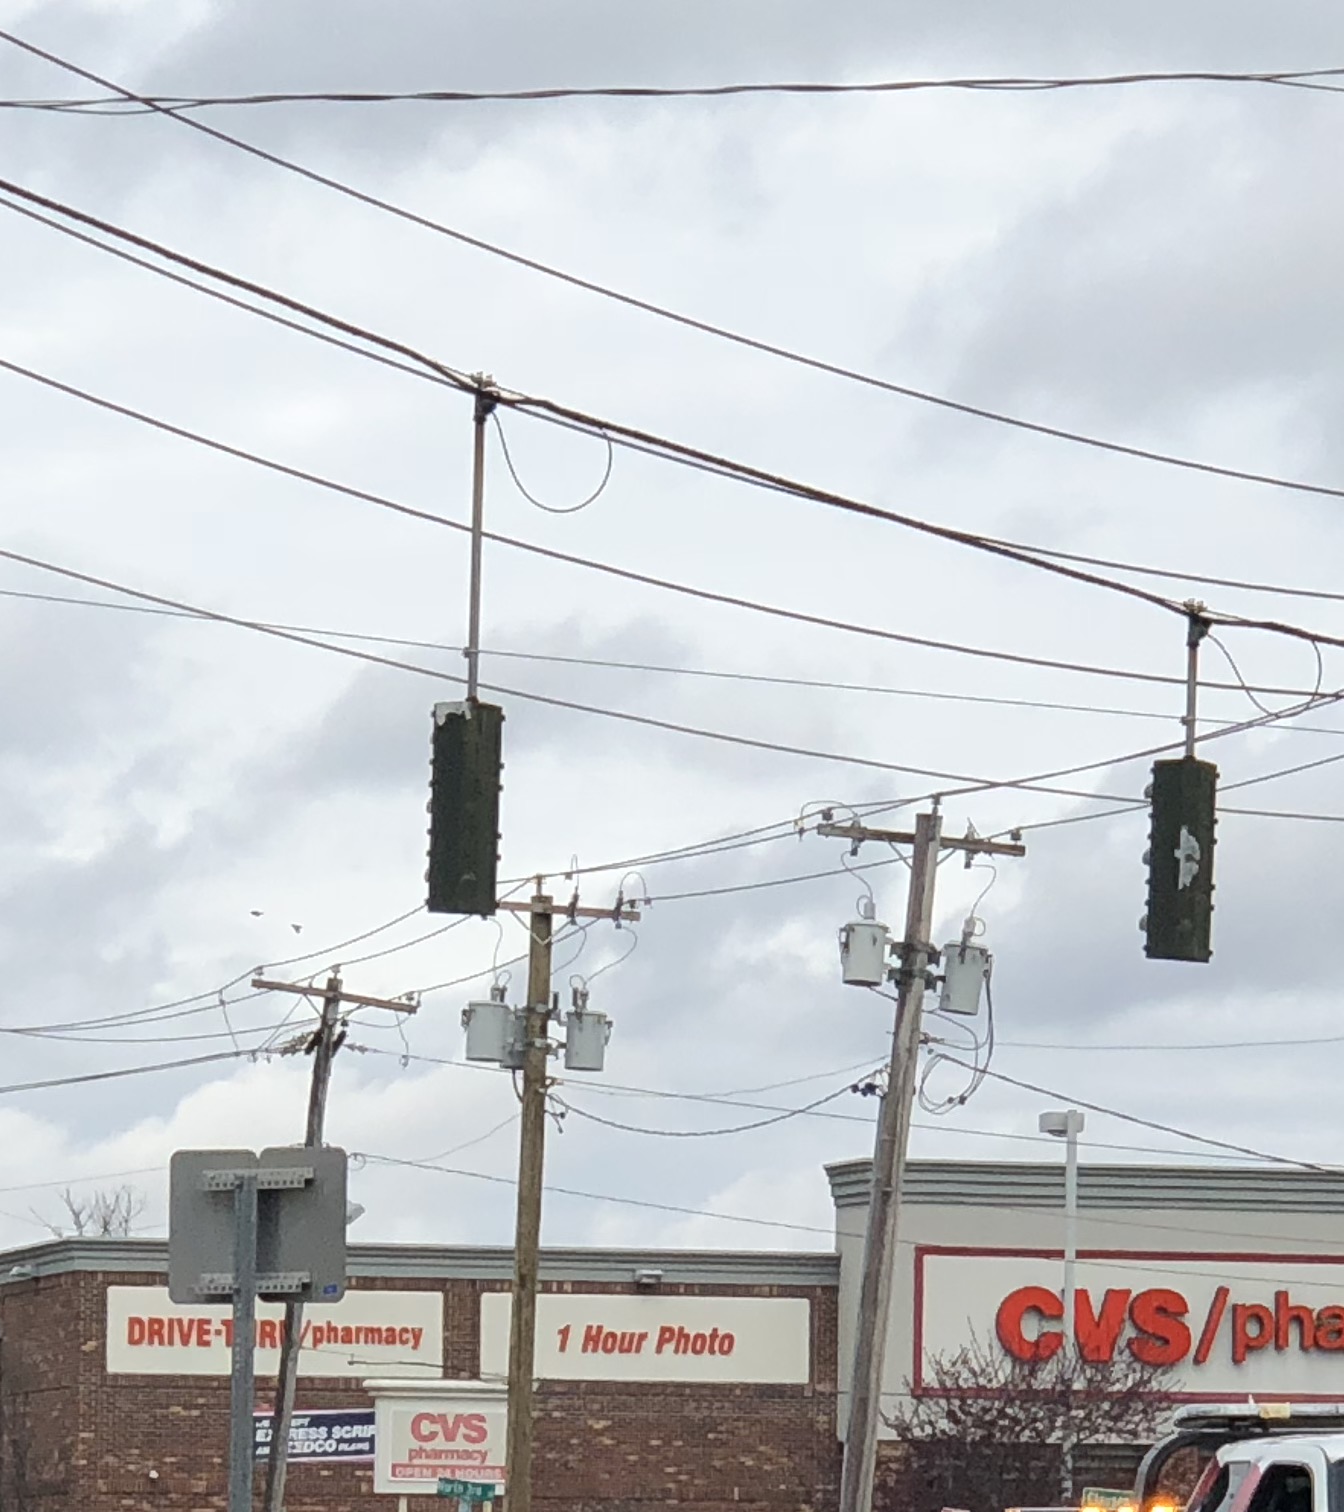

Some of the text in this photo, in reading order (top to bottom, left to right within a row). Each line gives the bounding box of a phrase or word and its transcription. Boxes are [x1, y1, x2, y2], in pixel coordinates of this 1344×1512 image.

[127, 1316, 423, 1350] DRIVE-TR/pharmacy
[557, 1324, 736, 1357] 1 Hour Photo
[410, 1412, 488, 1444] CVS
[408, 1446, 488, 1464] pharmacy
[396, 1467, 432, 1478] OPEN
[455, 1468, 503, 1480] HOURS
